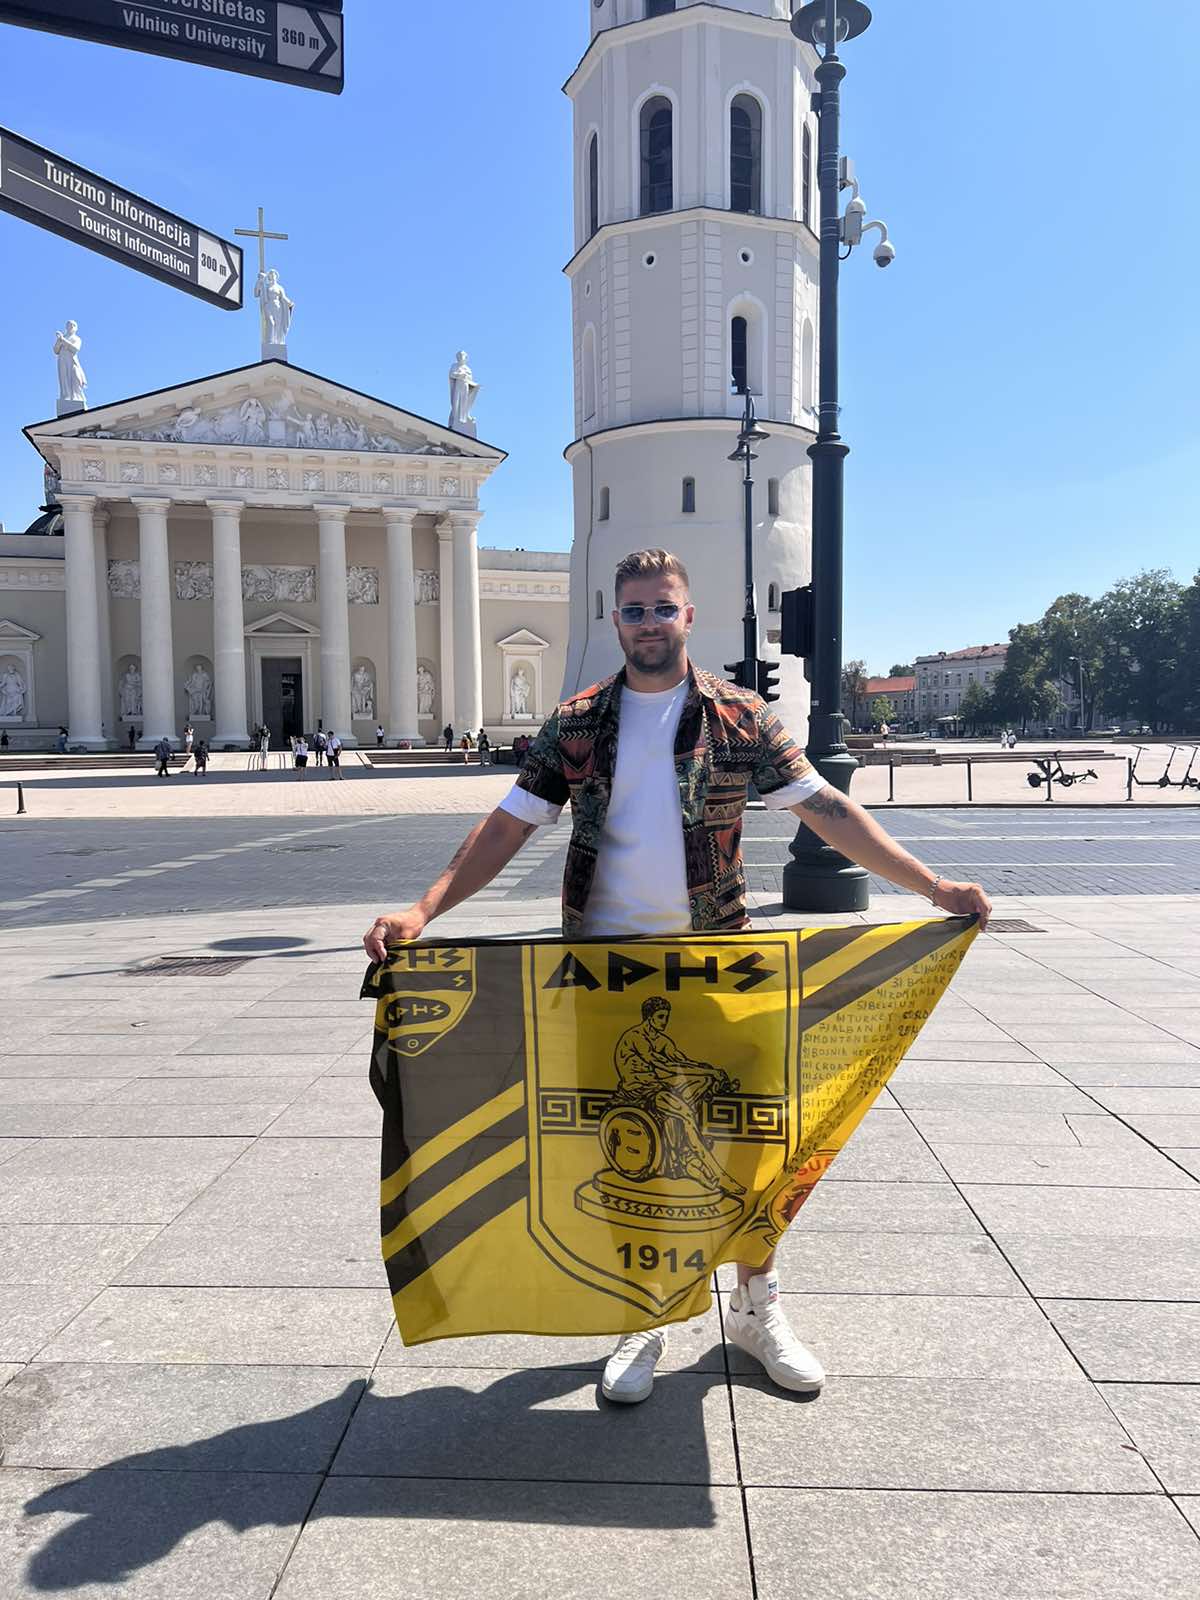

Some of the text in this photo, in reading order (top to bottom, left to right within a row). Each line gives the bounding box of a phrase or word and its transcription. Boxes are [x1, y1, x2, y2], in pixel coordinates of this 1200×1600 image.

[122, 9, 266, 59] Vilnius University
[282, 28, 320, 50] 360 m
[44, 159, 191, 247] Turizmo informacija
[78, 210, 190, 275] Tourist Information
[201, 253, 227, 277] 300 m
[616, 1242, 707, 1273] 1914
